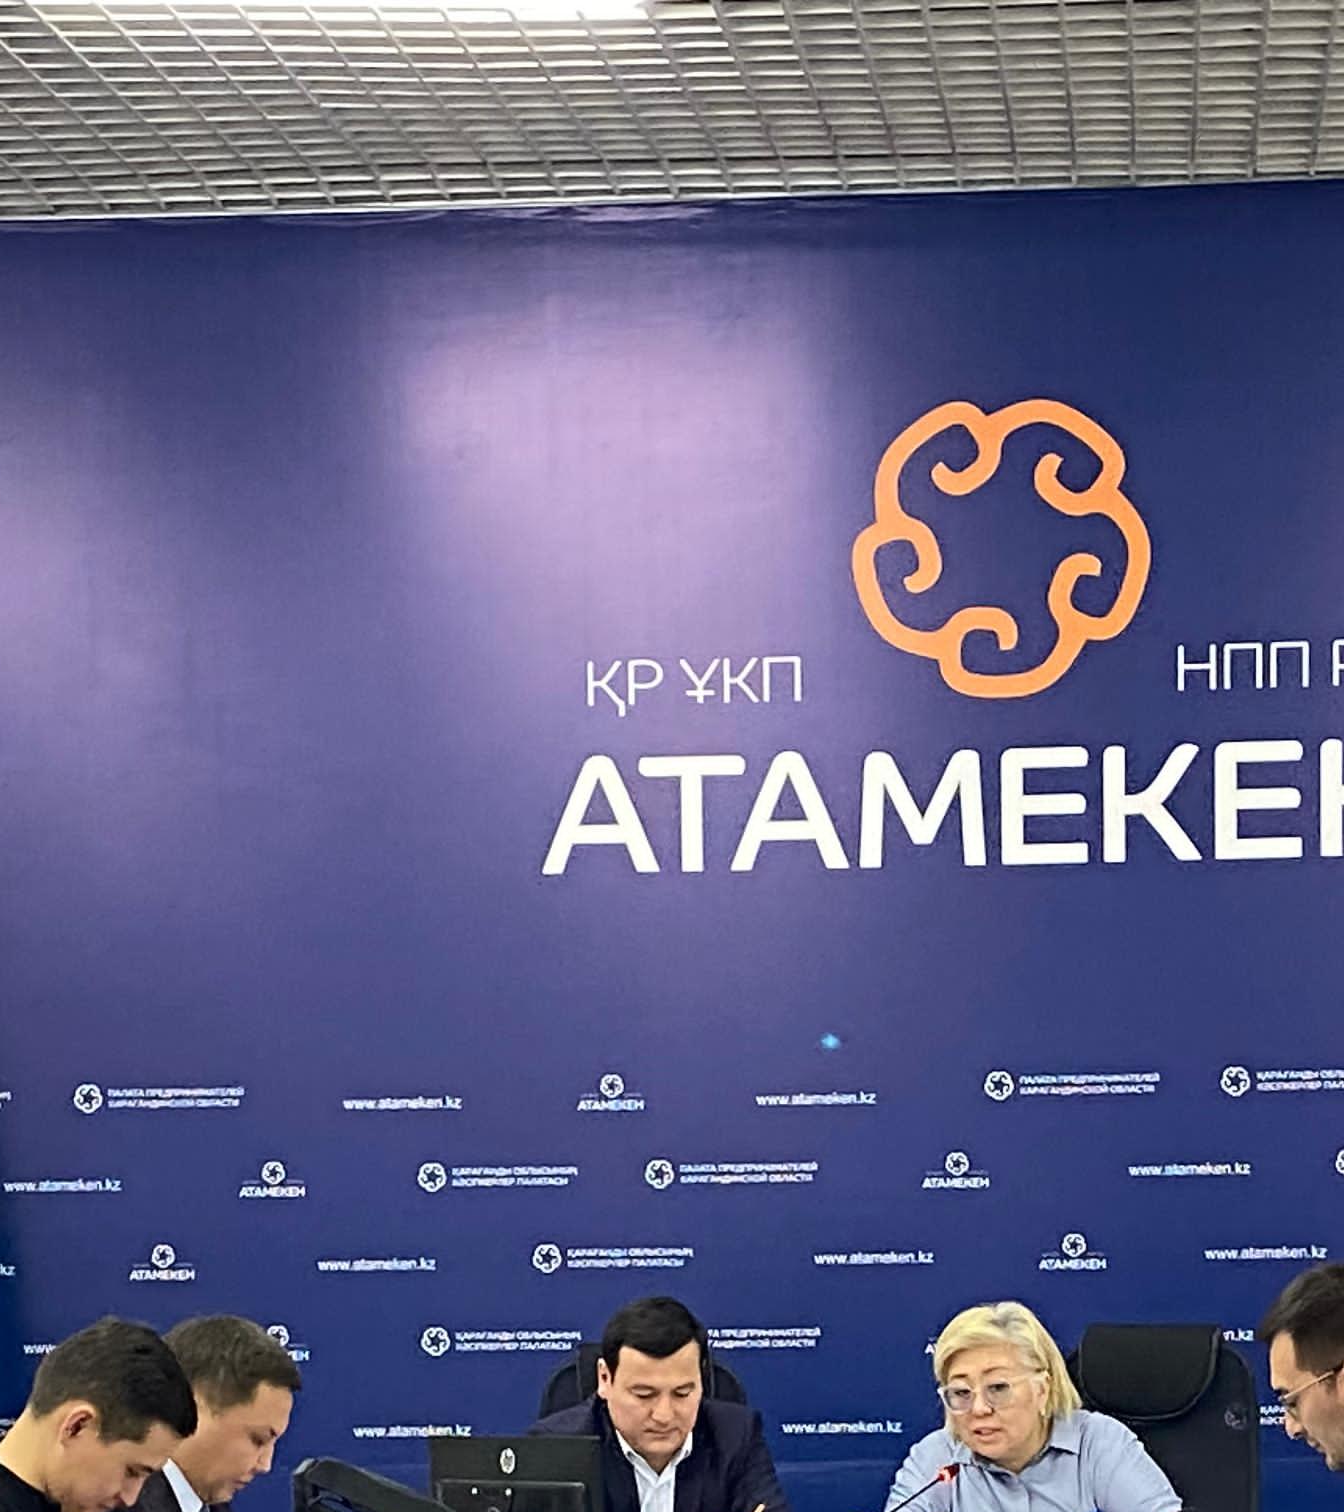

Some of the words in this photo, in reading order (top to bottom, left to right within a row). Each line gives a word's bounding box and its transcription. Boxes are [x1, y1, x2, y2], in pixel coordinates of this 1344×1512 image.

[586, 658, 664, 717] ҚР
[679, 655, 802, 704] ҰКП
[1177, 641, 1310, 691] НПП
